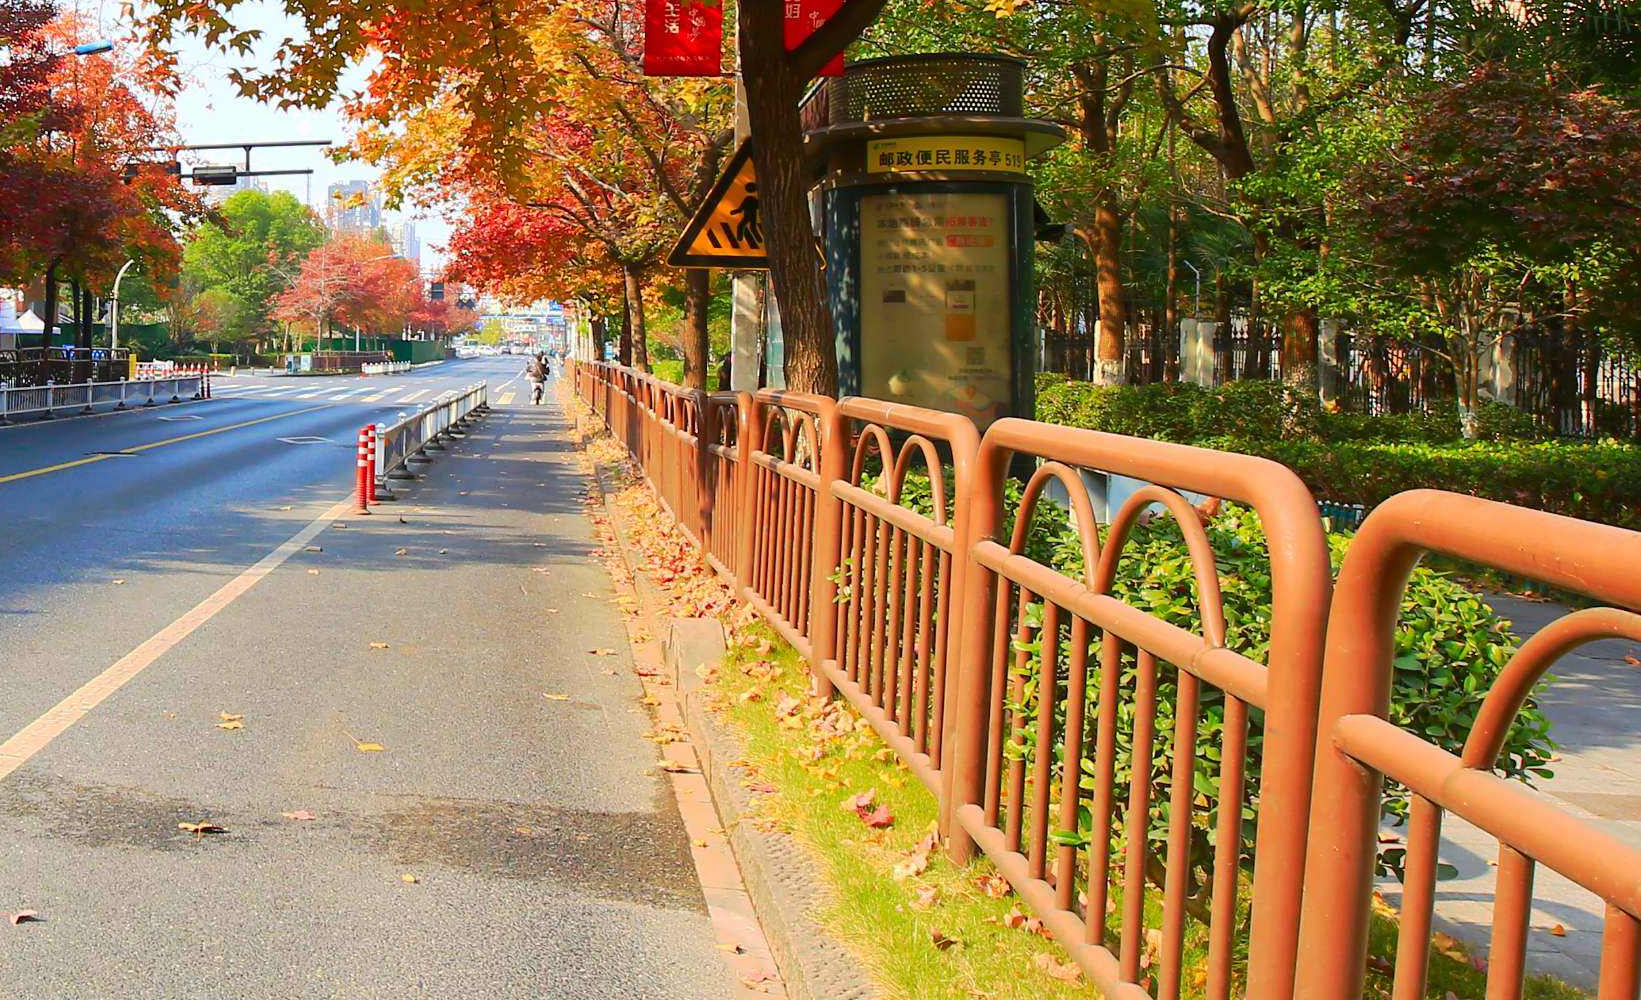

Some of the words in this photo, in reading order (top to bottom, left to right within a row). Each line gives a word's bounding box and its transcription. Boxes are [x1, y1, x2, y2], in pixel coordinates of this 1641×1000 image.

[879, 149, 1001, 167] 邮政便民服务亭
